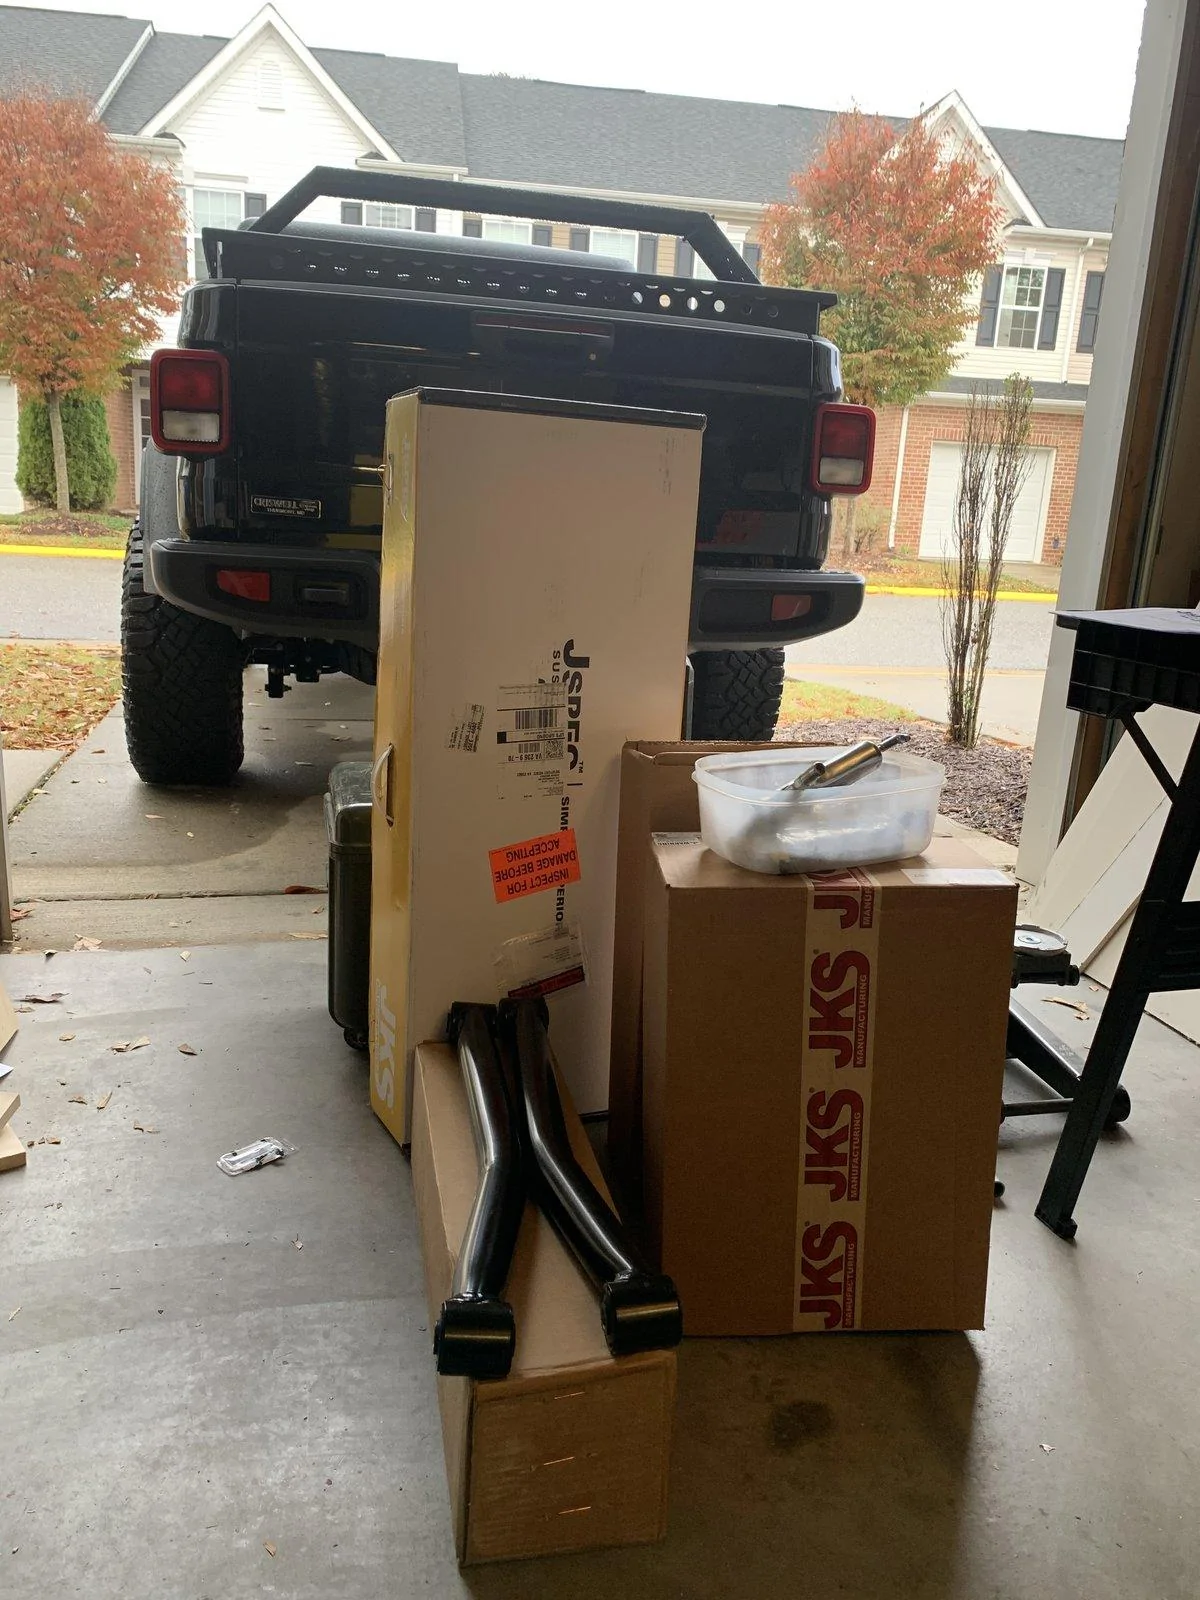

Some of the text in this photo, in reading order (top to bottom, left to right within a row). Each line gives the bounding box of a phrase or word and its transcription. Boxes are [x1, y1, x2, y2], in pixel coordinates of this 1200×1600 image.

[552, 650, 560, 684] SUS
[495, 850, 576, 883] DAMAGE BEFORE
[506, 838, 560, 863] ACCEPTING
[507, 868, 569, 895] INSPECT FOR
[806, 869, 860, 930] JK
[809, 950, 870, 1069] JKS
[856, 974, 868, 1066] MANUFACTURING
[804, 1089, 864, 1202] JKS
[850, 1111, 862, 1198] MANUFACTURING
[799, 1220, 858, 1330] JKS
[845, 1242, 856, 1326] MANUFACTURING
